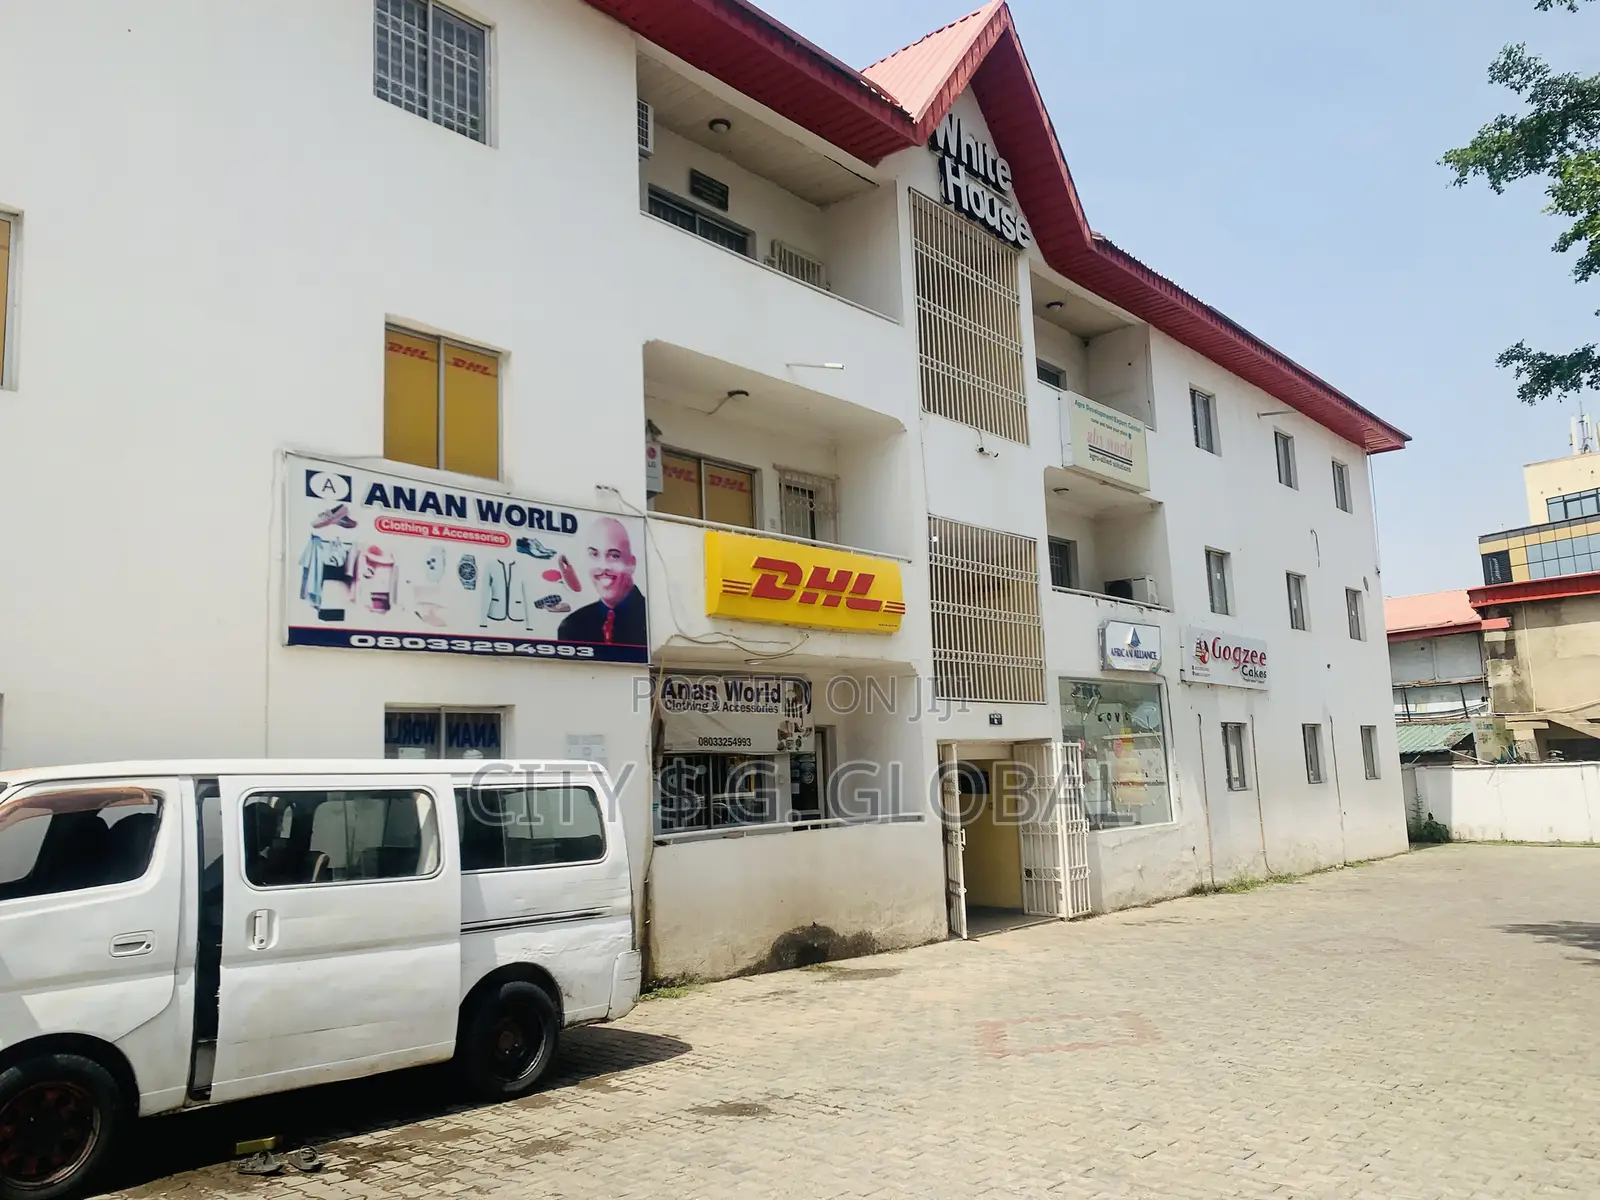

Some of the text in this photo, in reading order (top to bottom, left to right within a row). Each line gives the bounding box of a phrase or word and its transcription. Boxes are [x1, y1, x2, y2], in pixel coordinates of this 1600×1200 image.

[929, 112, 1012, 194] White
[938, 155, 1031, 249] House
[364, 482, 579, 535] ANAN WORLD
[381, 518, 506, 544] Clothing & Accessories
[751, 556, 883, 612] DHL
[350, 634, 595, 657] 08033294993
[1212, 636, 1267, 670] Gogzee
[1241, 664, 1267, 679] Cakes
[661, 677, 781, 704] Anan World
[665, 700, 779, 714] Clothing & Accessories
